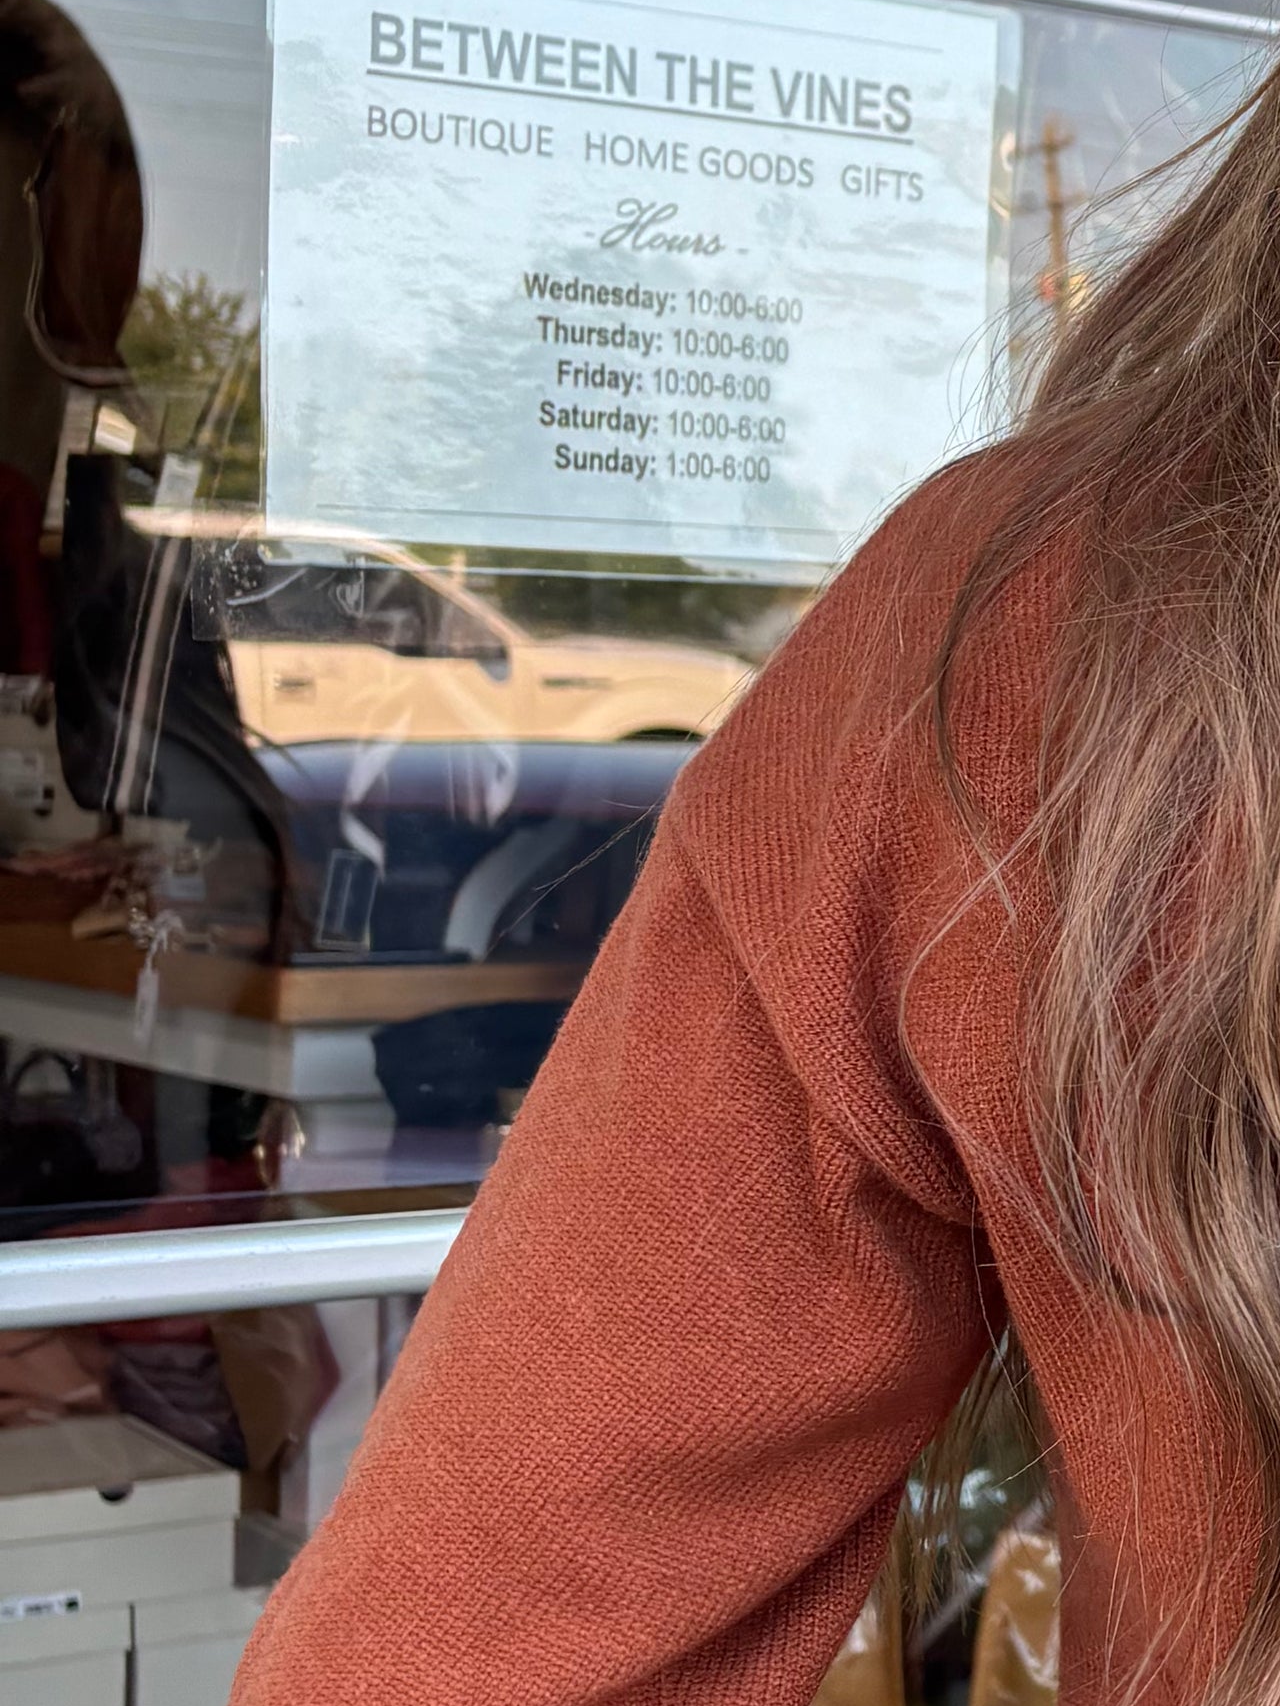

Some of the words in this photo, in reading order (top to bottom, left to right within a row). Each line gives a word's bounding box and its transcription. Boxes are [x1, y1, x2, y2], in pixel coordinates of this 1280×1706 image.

[369, 10, 638, 97] BETWEEN
[655, 50, 755, 114] THE
[769, 65, 914, 135] VINES
[366, 104, 555, 158] BOUTIQUE
[584, 130, 690, 175] HOME
[698, 145, 815, 189] GOODS
[839, 163, 925, 203] GIFTS
[600, 197, 725, 256] Hours
[523, 272, 677, 318] Wednesday:
[686, 289, 804, 324] 10:00-6:00
[536, 315, 663, 358] Thursday:
[672, 328, 790, 364] 10:00-6:00
[556, 358, 644, 398] Friday:
[652, 367, 772, 402] 10:00-6:00
[539, 400, 659, 441] Saturday:
[668, 409, 787, 443] 10:00-6:00
[554, 442, 657, 482] Sunday:
[665, 450, 772, 484] 1:00-6:00
